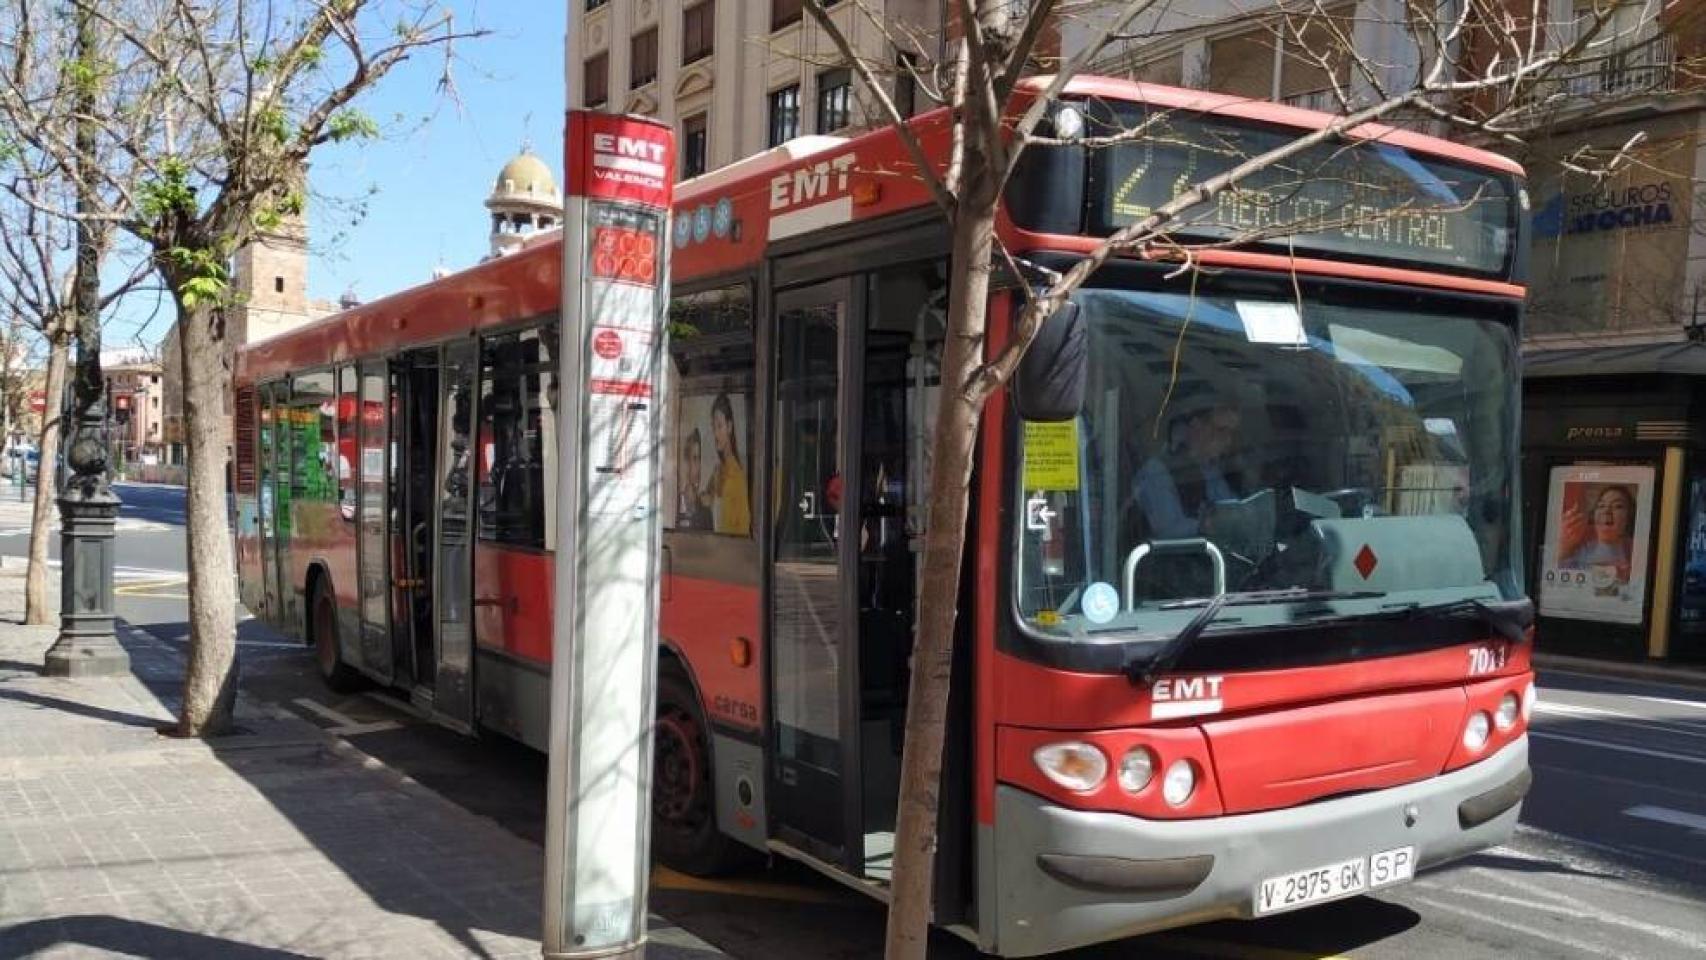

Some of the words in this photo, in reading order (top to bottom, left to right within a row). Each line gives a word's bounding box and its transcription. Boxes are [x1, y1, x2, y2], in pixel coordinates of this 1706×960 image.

[594, 133, 665, 163] EMT
[770, 152, 855, 210] EMT
[1341, 204, 1453, 250] CENTRAL
[1567, 427, 1622, 440] prensa
[1152, 676, 1224, 700] EMT
[1284, 870, 1331, 903] 2975
